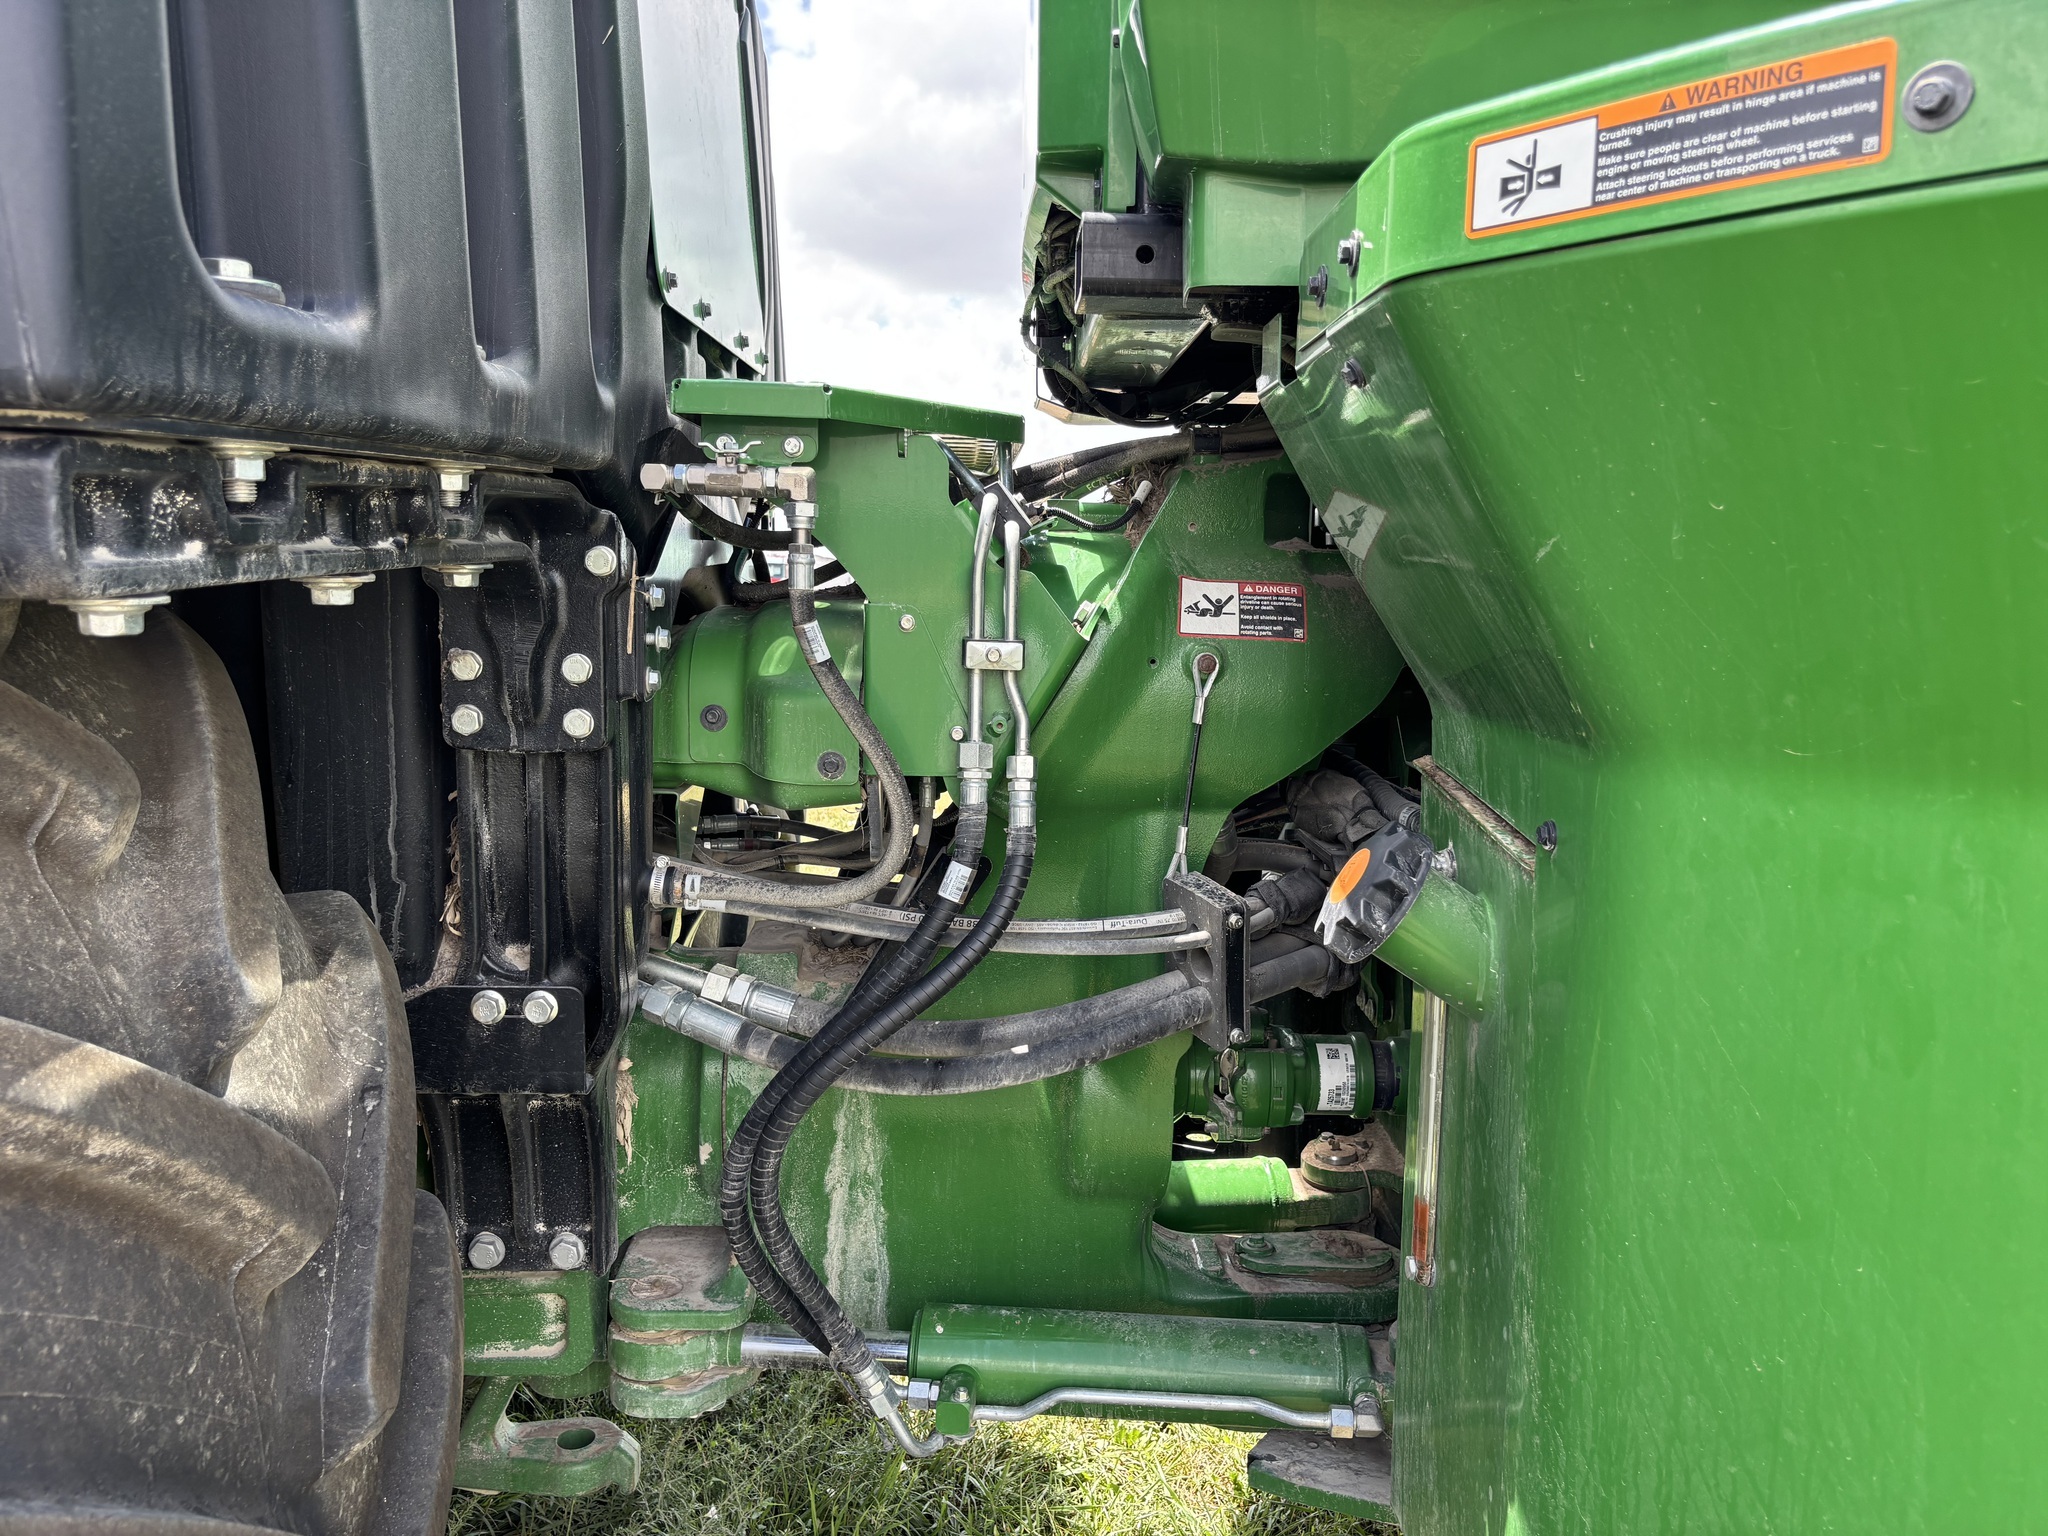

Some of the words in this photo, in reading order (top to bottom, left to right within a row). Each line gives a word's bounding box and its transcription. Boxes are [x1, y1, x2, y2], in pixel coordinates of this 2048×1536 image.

[1685, 62, 1803, 106] WARNING
[1598, 125, 1642, 142] Crushing
[1644, 117, 1673, 132] injury
[1676, 112, 1697, 124] may
[1699, 103, 1730, 119] result
[1732, 100, 1742, 111] in
[1745, 93, 1777, 109] hinge
[1778, 88, 1804, 102] area
[1805, 84, 1815, 95] if
[1816, 74, 1867, 93] machine
[1868, 71, 1881, 82] is
[1597, 154, 1622, 167] Make
[1624, 150, 1646, 162] sure
[1647, 141, 1681, 158] people
[1683, 137, 1700, 148] are
[1702, 131, 1728, 144] clear
[1730, 126, 1742, 138] of
[1743, 118, 1790, 135] machine
[1791, 110, 1829, 126] before
[1830, 100, 1878, 119] starting
[1598, 138, 1632, 152] turned.
[1595, 192, 1615, 202] near
[1617, 185, 1646, 198] center
[1648, 181, 1659, 191] of
[1660, 172, 1701, 189] machine
[1703, 170, 1714, 180] or
[1716, 157, 1781, 177] transporting
[1782, 154, 1796, 165] on
[1798, 152, 1807, 162] a
[1808, 147, 1840, 160] truck.
[1596, 179, 1625, 192] Attach
[1627, 170, 1666, 186] steering
[1667, 160, 1709, 177] lockouts
[1711, 153, 1743, 168] before
[1745, 142, 1804, 163] performing
[1806, 132, 1855, 149] services
[1597, 165, 1629, 178] engine
[1630, 161, 1641, 170] or
[1643, 153, 1680, 168] moving
[1682, 143, 1723, 160] steering
[1726, 135, 1761, 150] wheel.
[1255, 585, 1298, 595] DANGER
[1110, 918, 1148, 929] Dura-Tuff
